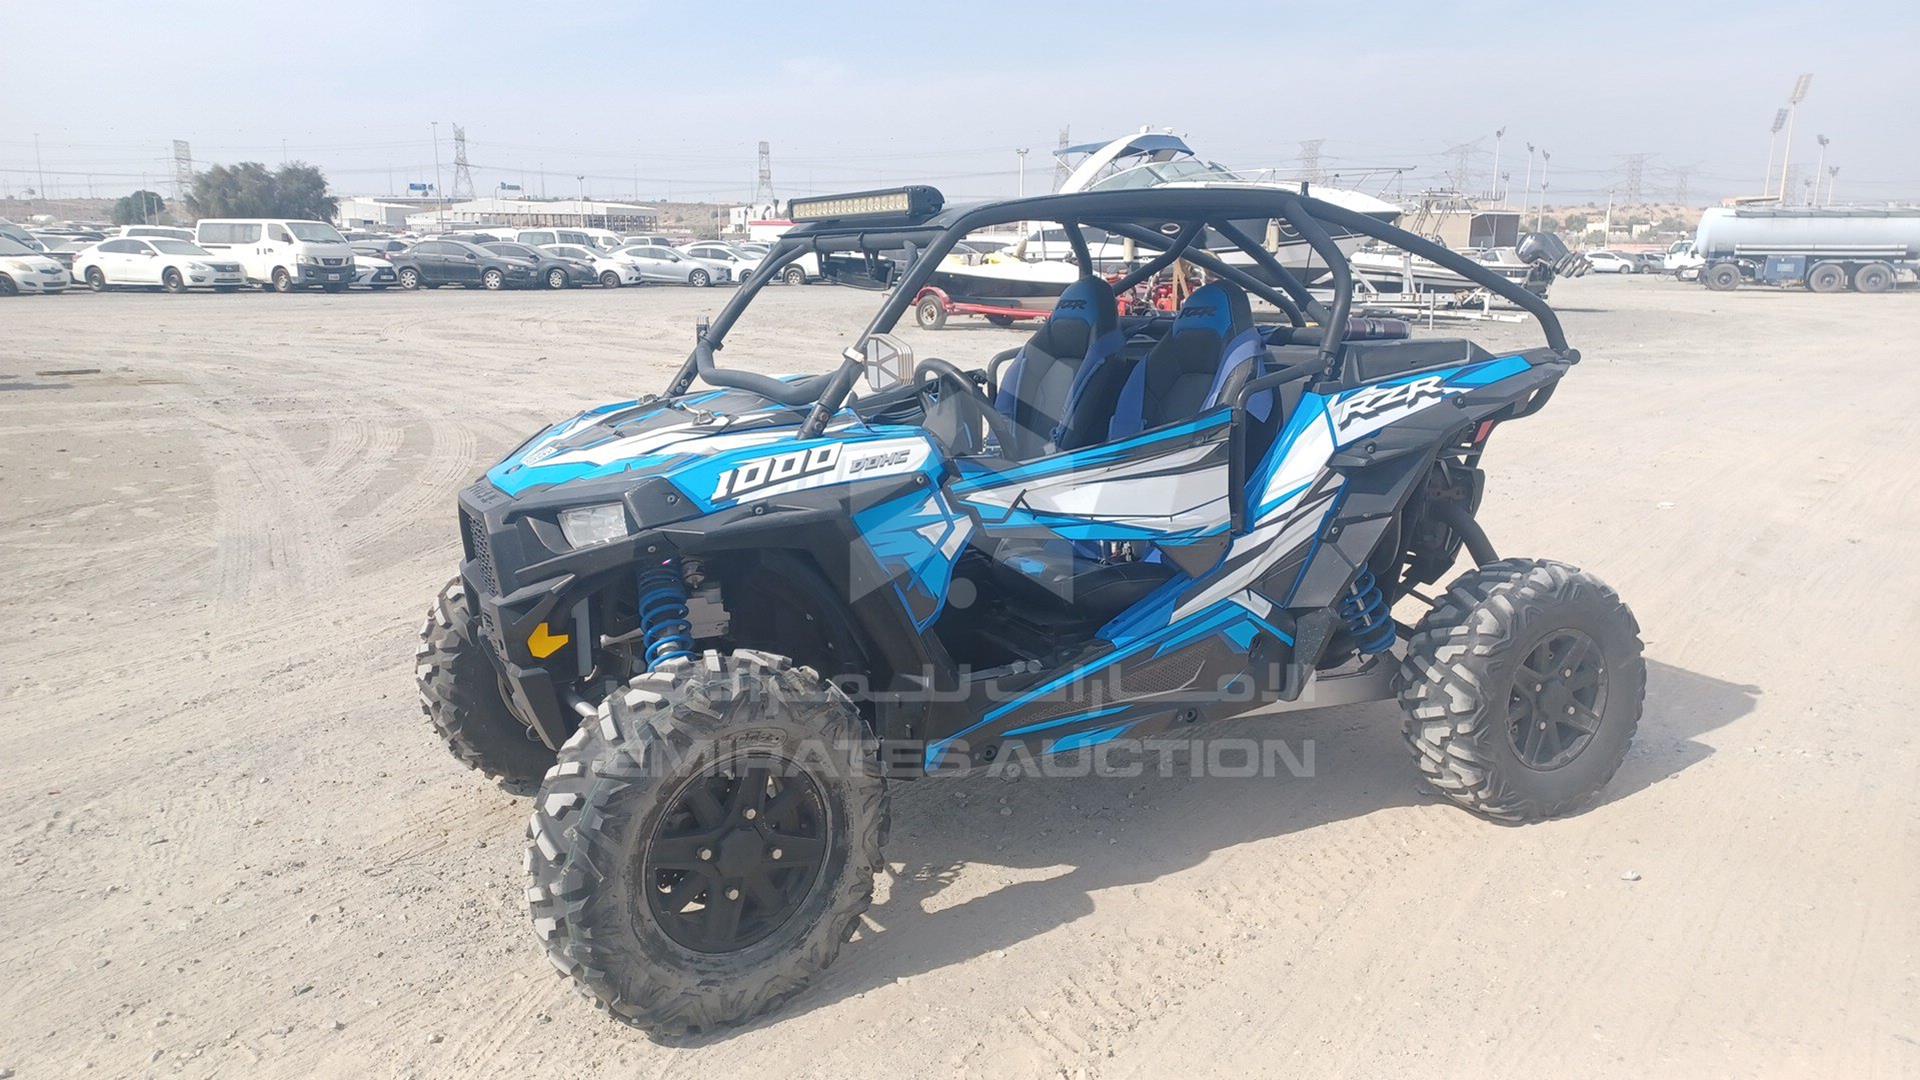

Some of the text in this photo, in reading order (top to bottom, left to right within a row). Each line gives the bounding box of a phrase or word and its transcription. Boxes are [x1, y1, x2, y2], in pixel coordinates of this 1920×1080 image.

[1056, 299, 1088, 310] RZR
[1334, 375, 1443, 431] RZR
[711, 443, 911, 504] 1000 DOHC
